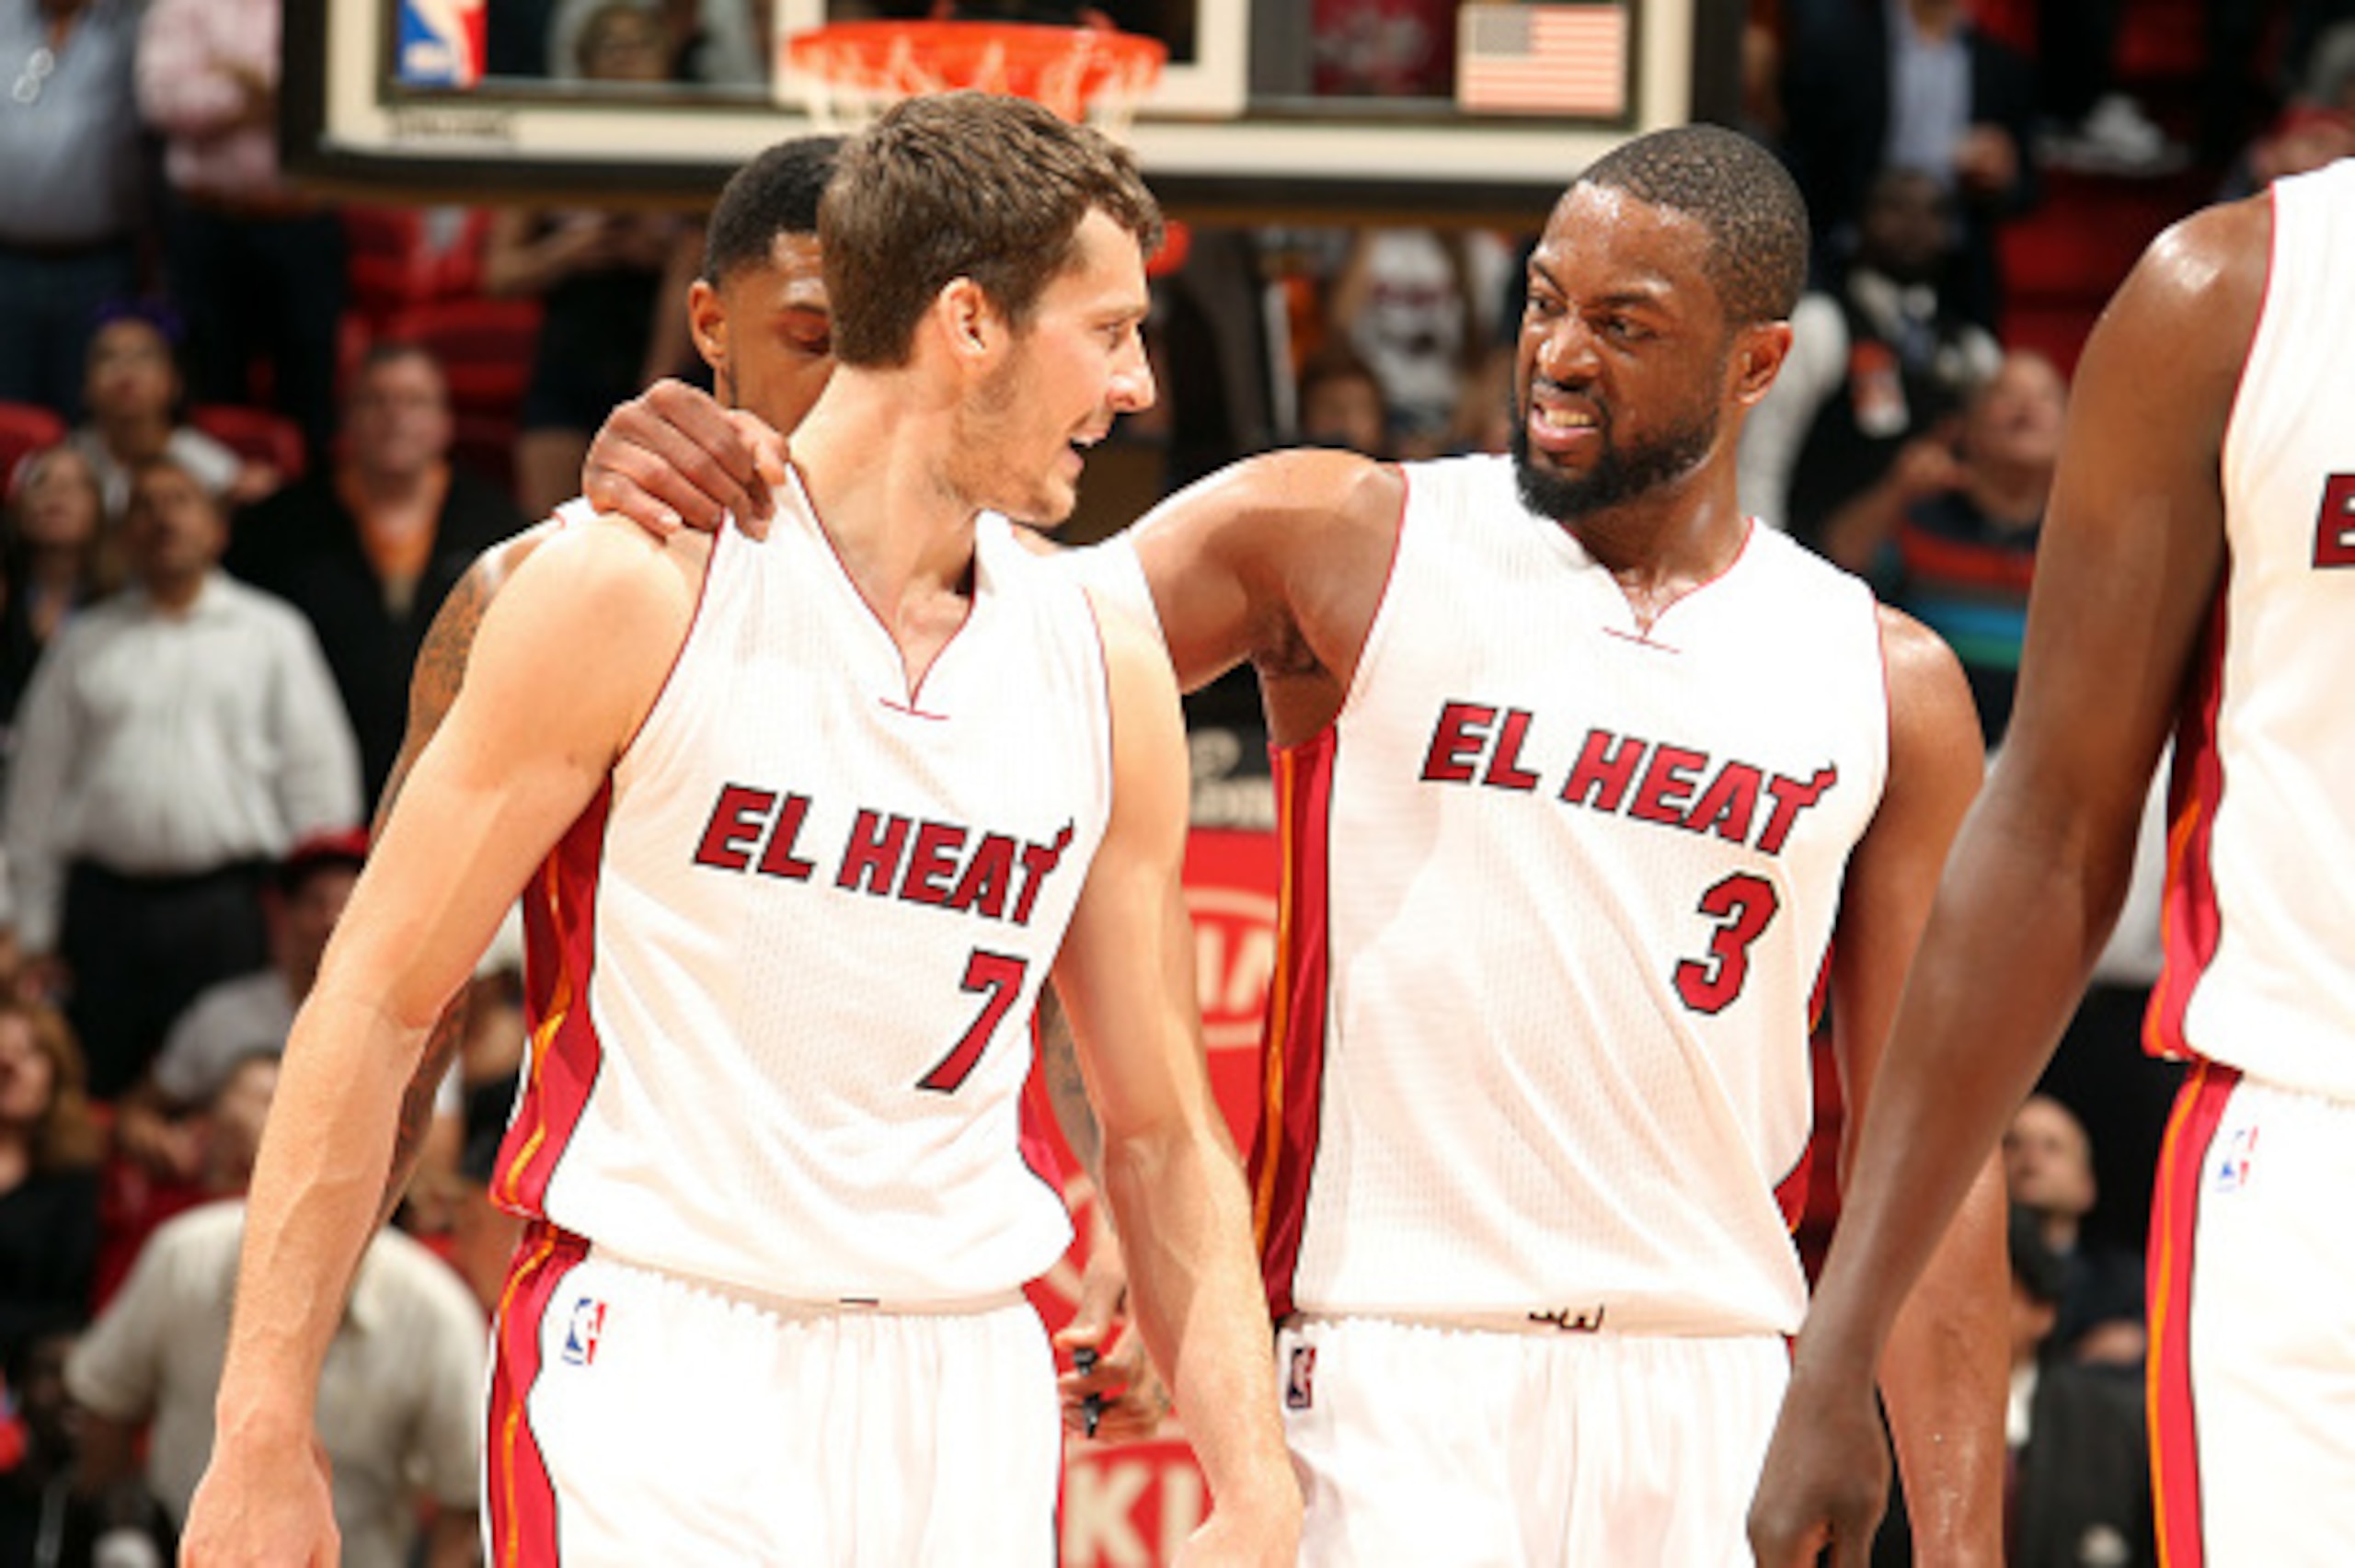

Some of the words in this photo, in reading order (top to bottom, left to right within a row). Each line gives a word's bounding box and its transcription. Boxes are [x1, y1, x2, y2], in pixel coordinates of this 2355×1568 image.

[1419, 699, 1542, 791] EL
[1557, 728, 1838, 856] HEAT
[692, 782, 817, 881] EL
[833, 807, 1074, 927] HEAT
[1671, 871, 1779, 1015] 3
[914, 945, 1029, 1094] 7
